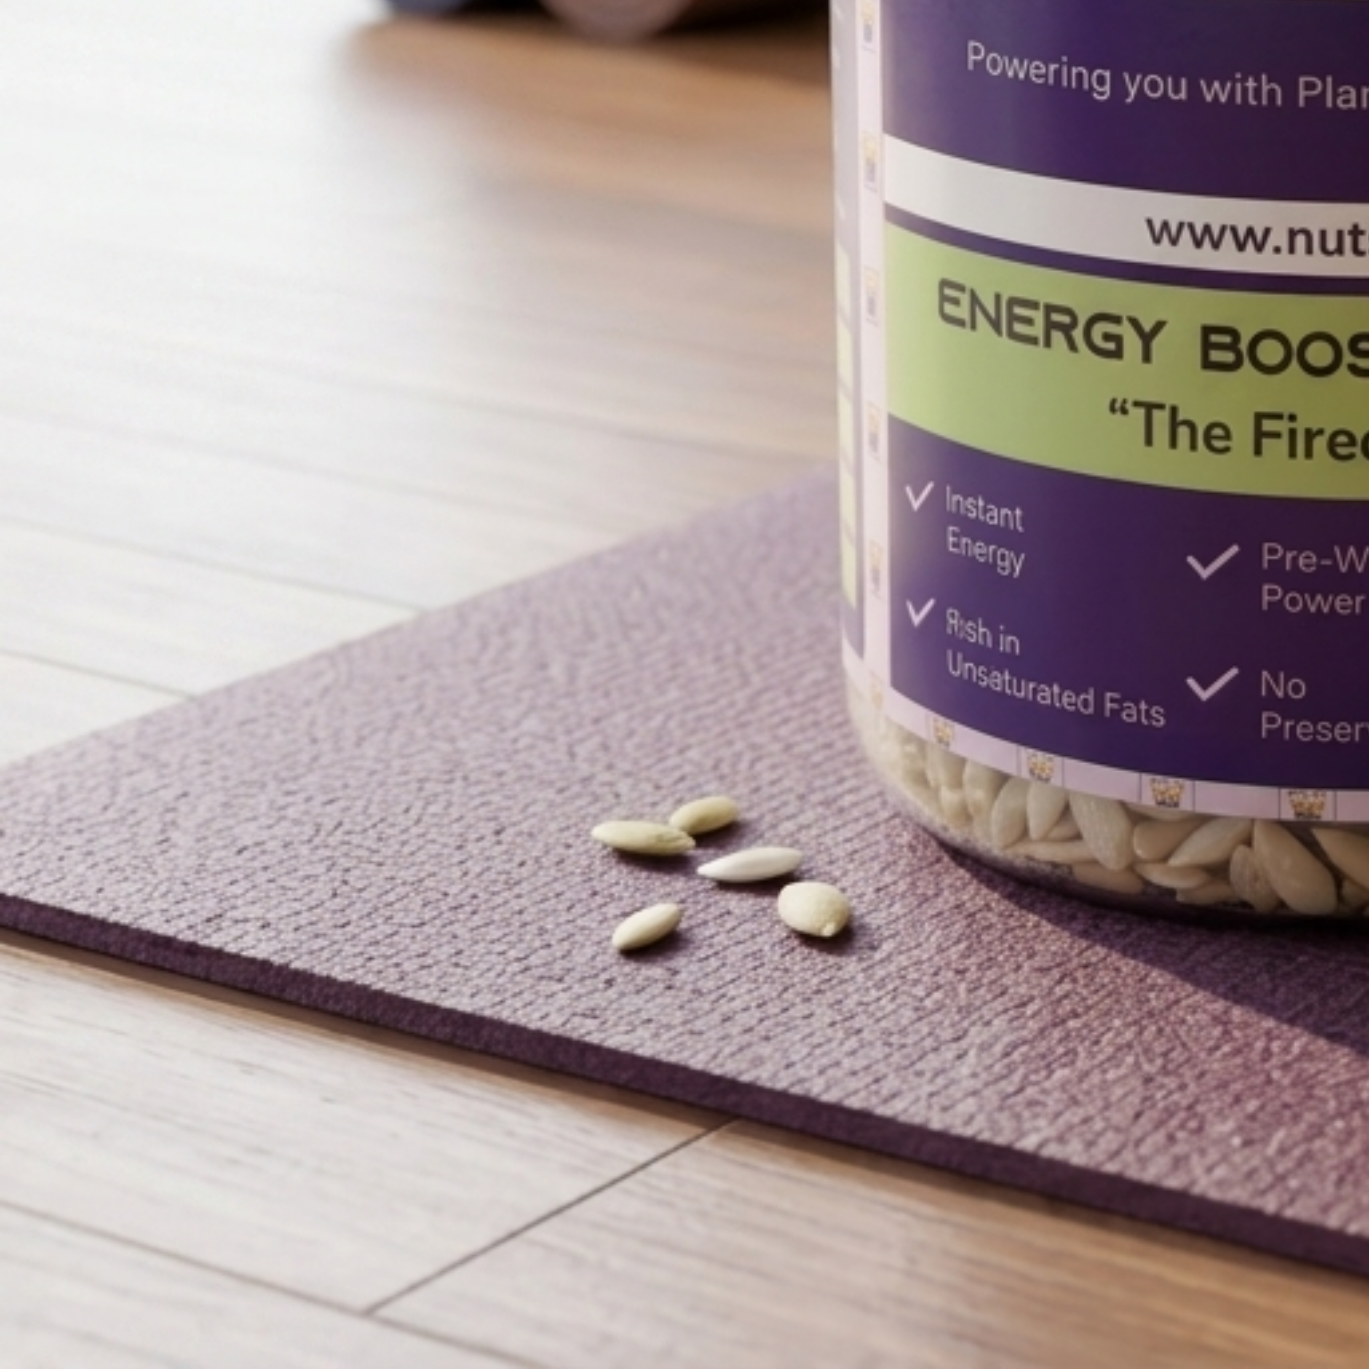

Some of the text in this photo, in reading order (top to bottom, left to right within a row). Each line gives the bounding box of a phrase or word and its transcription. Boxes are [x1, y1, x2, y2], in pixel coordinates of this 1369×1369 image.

[966, 39, 1112, 102] Powering
[1122, 71, 1188, 105] you
[1199, 71, 1283, 108] with
[937, 277, 1168, 365] ENERGY
[945, 484, 1025, 533] Instant
[946, 525, 1026, 579] Energy
[1260, 582, 1367, 615] Power
[998, 624, 1021, 656] in
[946, 649, 1167, 729] Unsaturated Fats
[1260, 669, 1307, 700] No
